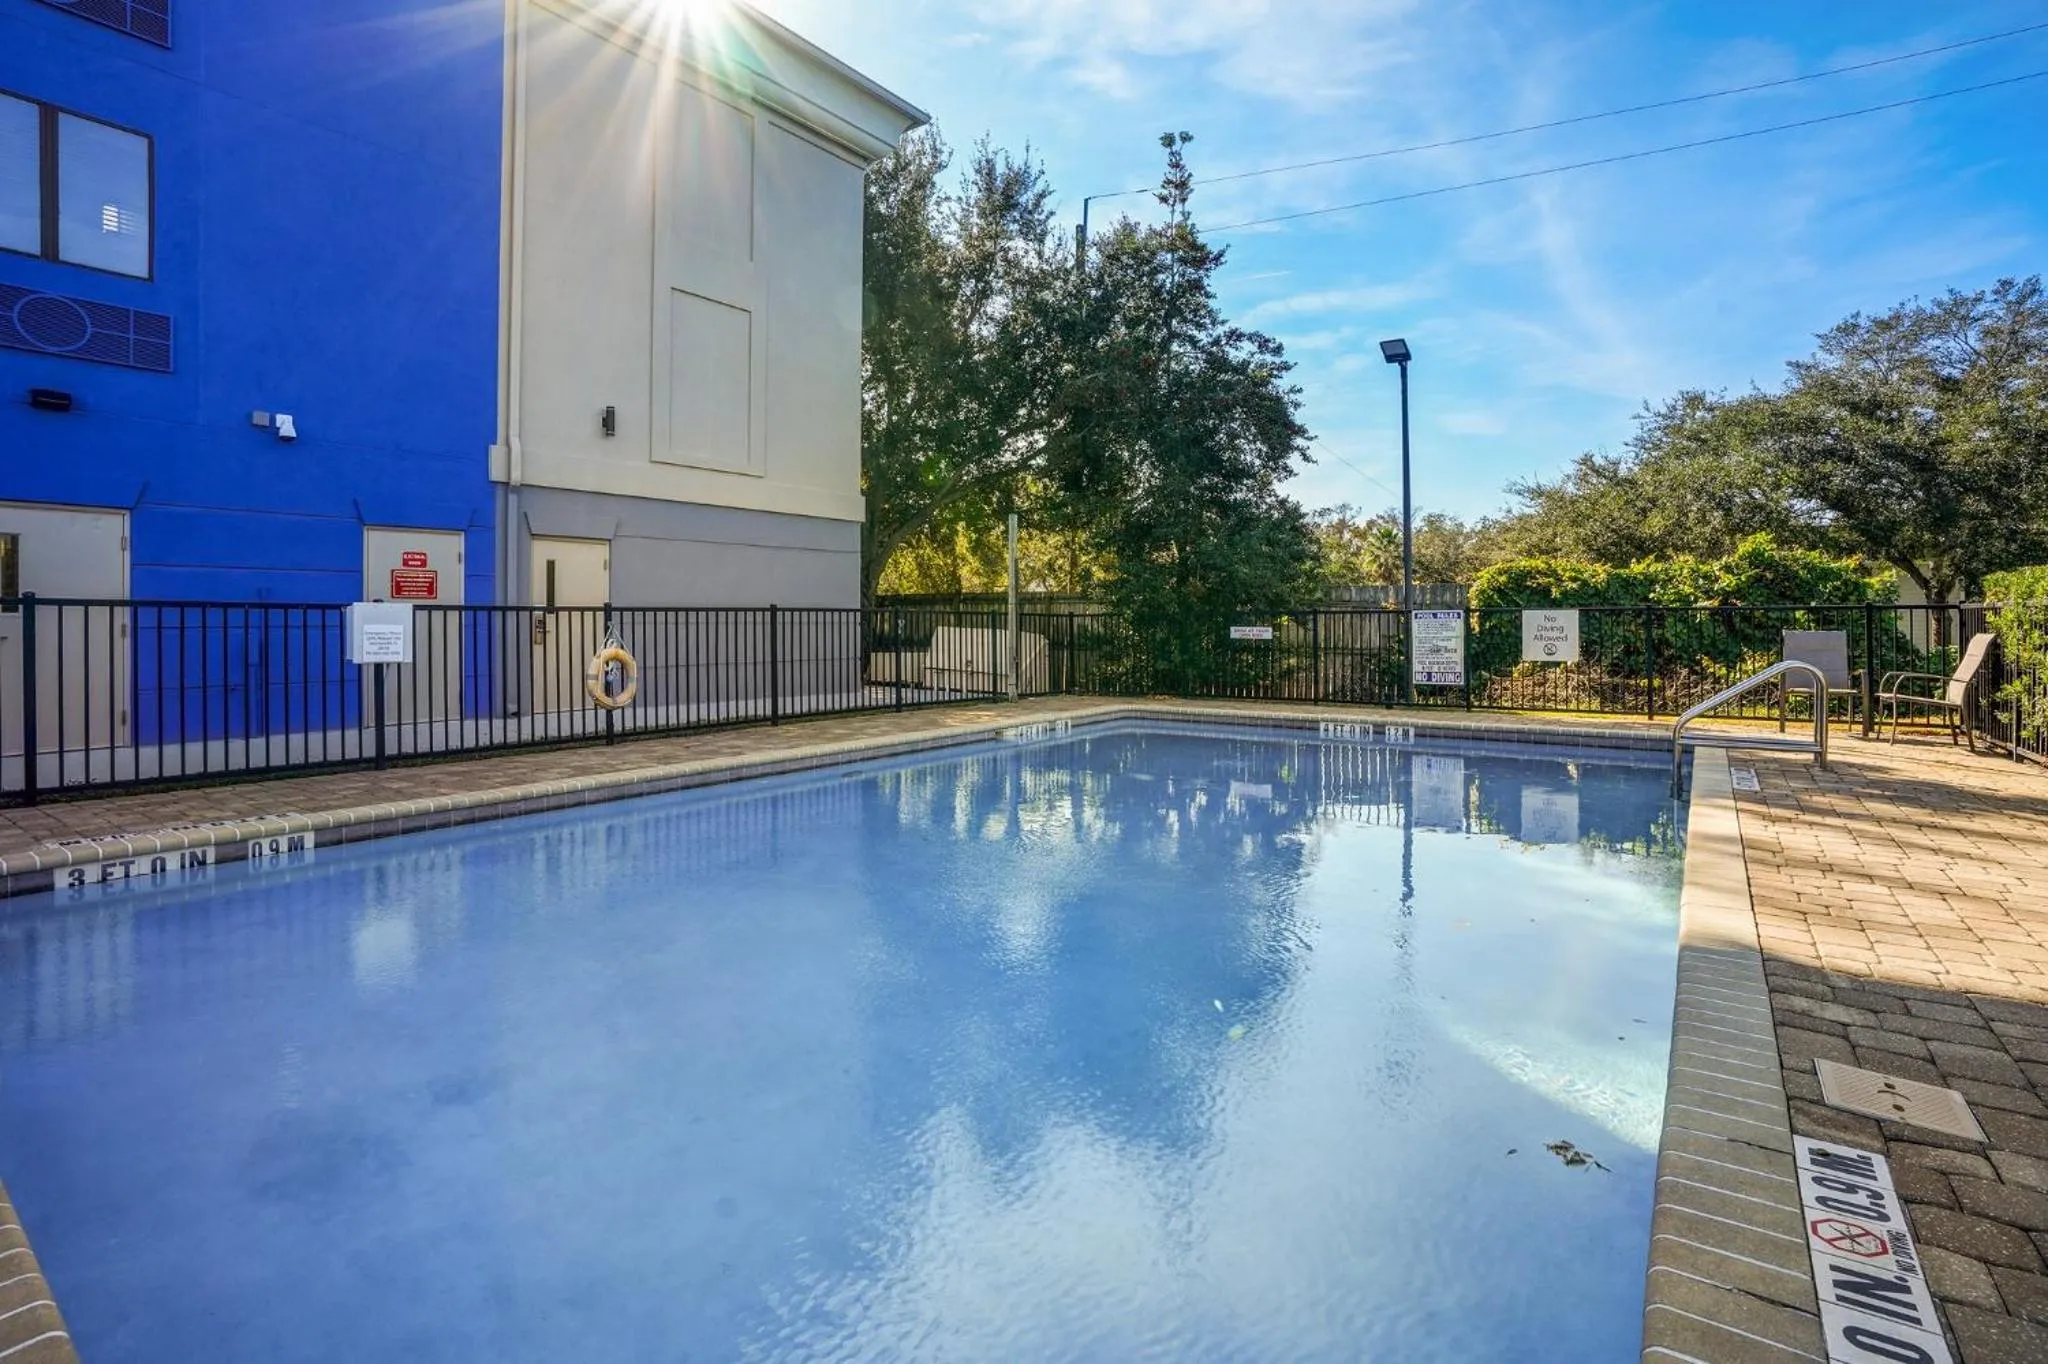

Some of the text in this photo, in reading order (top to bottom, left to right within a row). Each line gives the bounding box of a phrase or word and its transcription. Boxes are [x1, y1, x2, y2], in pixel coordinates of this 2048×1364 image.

[1536, 624, 1564, 634] Diving
[1533, 633, 1568, 642] Allowed
[1415, 672, 1461, 682] NO DIVING
[68, 868, 85, 887] 3
[101, 859, 135, 882] FT
[151, 856, 167, 874] 0
[180, 849, 207, 869] IN
[1887, 1229, 1920, 1276] NO DIVING
